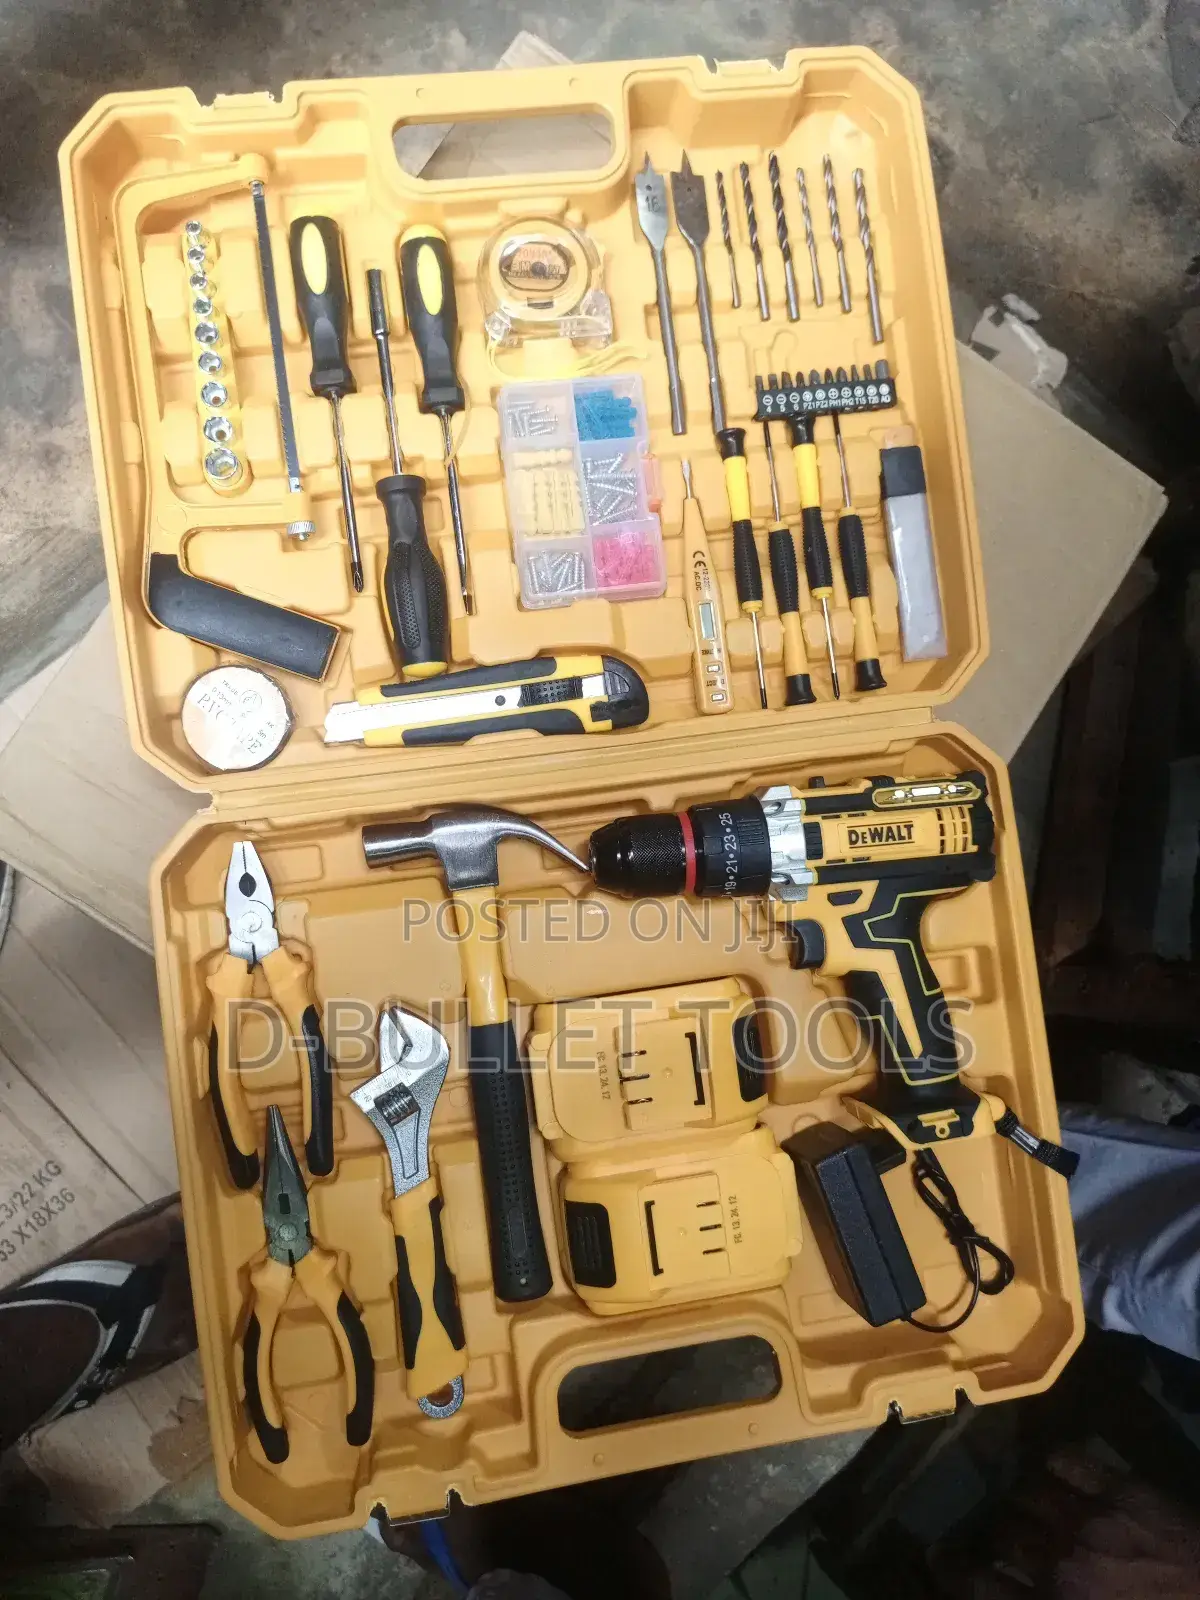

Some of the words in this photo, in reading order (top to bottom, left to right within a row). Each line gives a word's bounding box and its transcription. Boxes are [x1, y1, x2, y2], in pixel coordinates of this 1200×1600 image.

[803, 402, 815, 410] PZ1
[816, 399, 828, 408] PZ2
[829, 399, 841, 407] PH1
[841, 397, 854, 406] PH2
[855, 396, 866, 405] T15
[32, 1160, 62, 1188] KG
